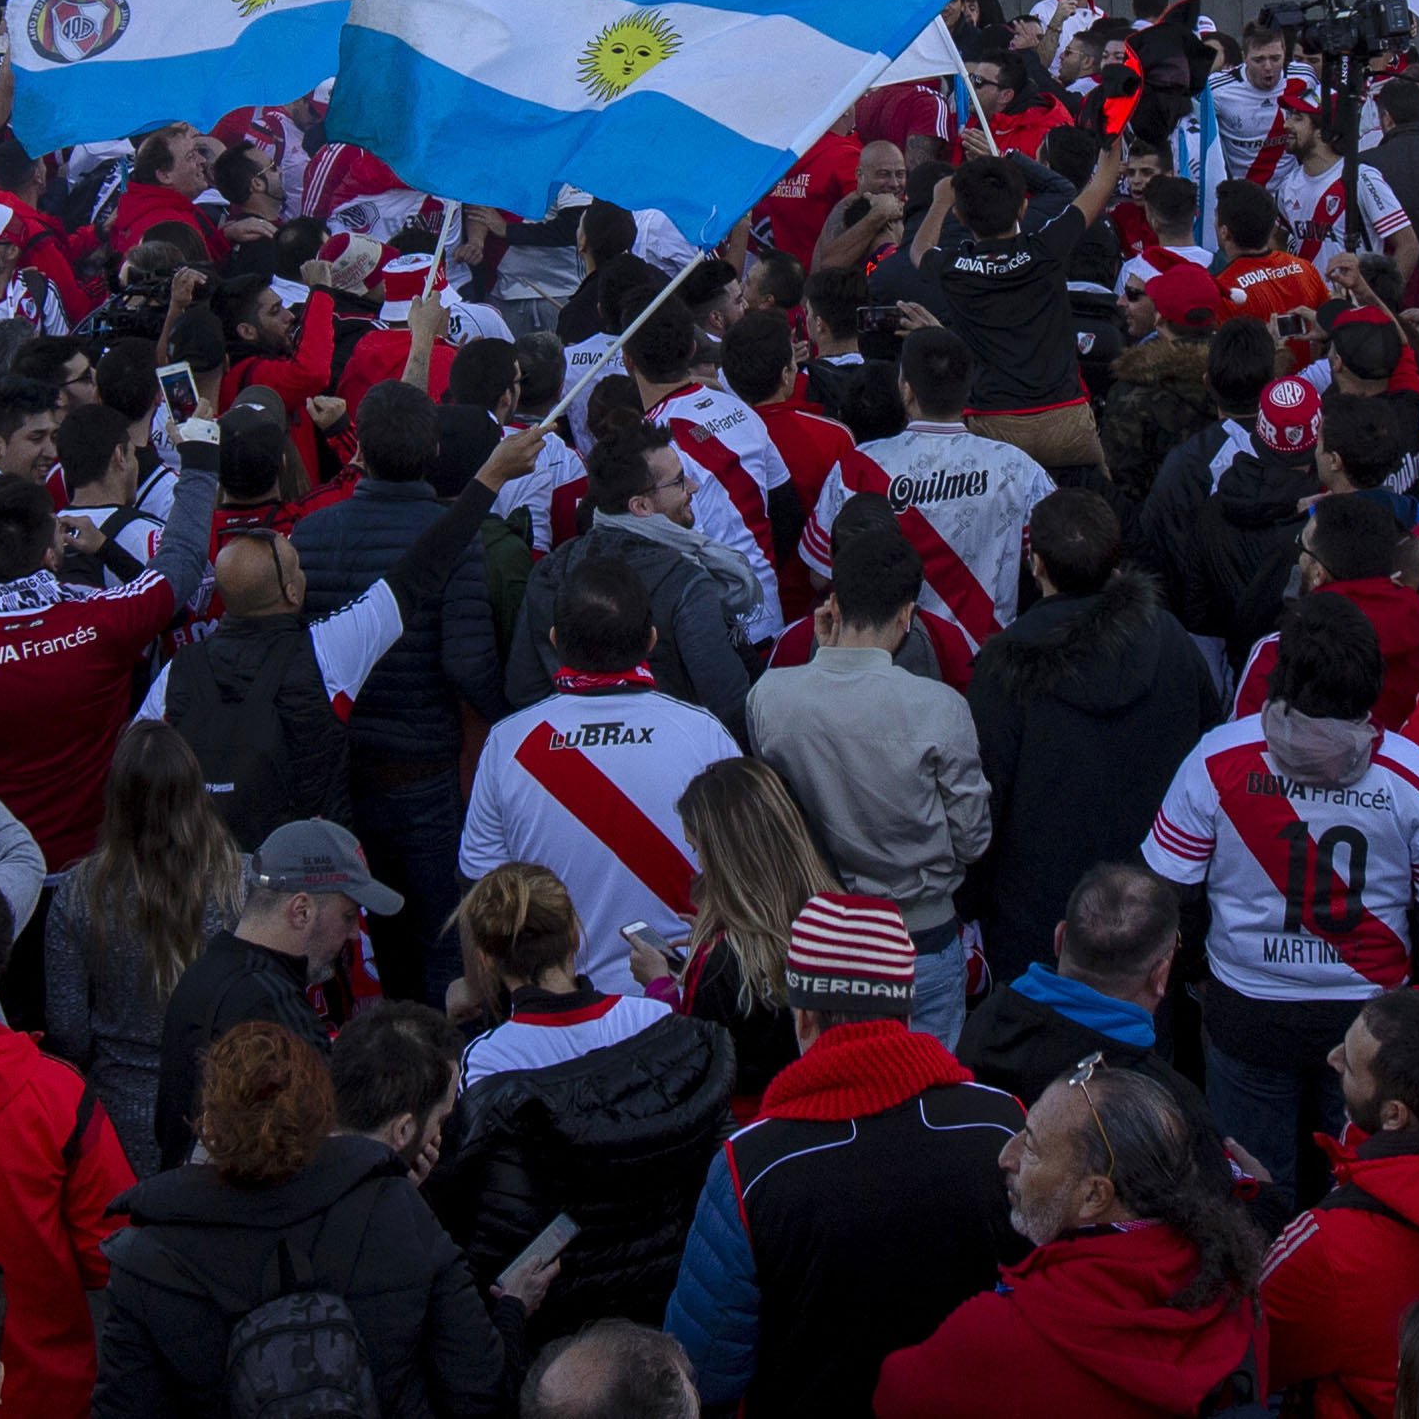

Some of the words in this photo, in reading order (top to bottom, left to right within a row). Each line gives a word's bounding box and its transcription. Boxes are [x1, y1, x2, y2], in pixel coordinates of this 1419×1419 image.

[1341, 55, 1349, 86] SONY
[769, 186, 807, 199] ARCELONA
[954, 256, 985, 275] BBVA
[985, 250, 1032, 275] Francés
[1236, 265, 1268, 288] BBVA
[1265, 260, 1303, 281] Francés
[1270, 383, 1304, 405] CARP
[714, 405, 748, 435] Francés
[888, 470, 989, 515] Quilmes
[22, 626, 98, 661] Francés
[549, 722, 655, 750] LUBRAX
[1245, 770, 1306, 800] BBVA
[1310, 784, 1392, 811] Francés
[1278, 821, 1366, 935] 10
